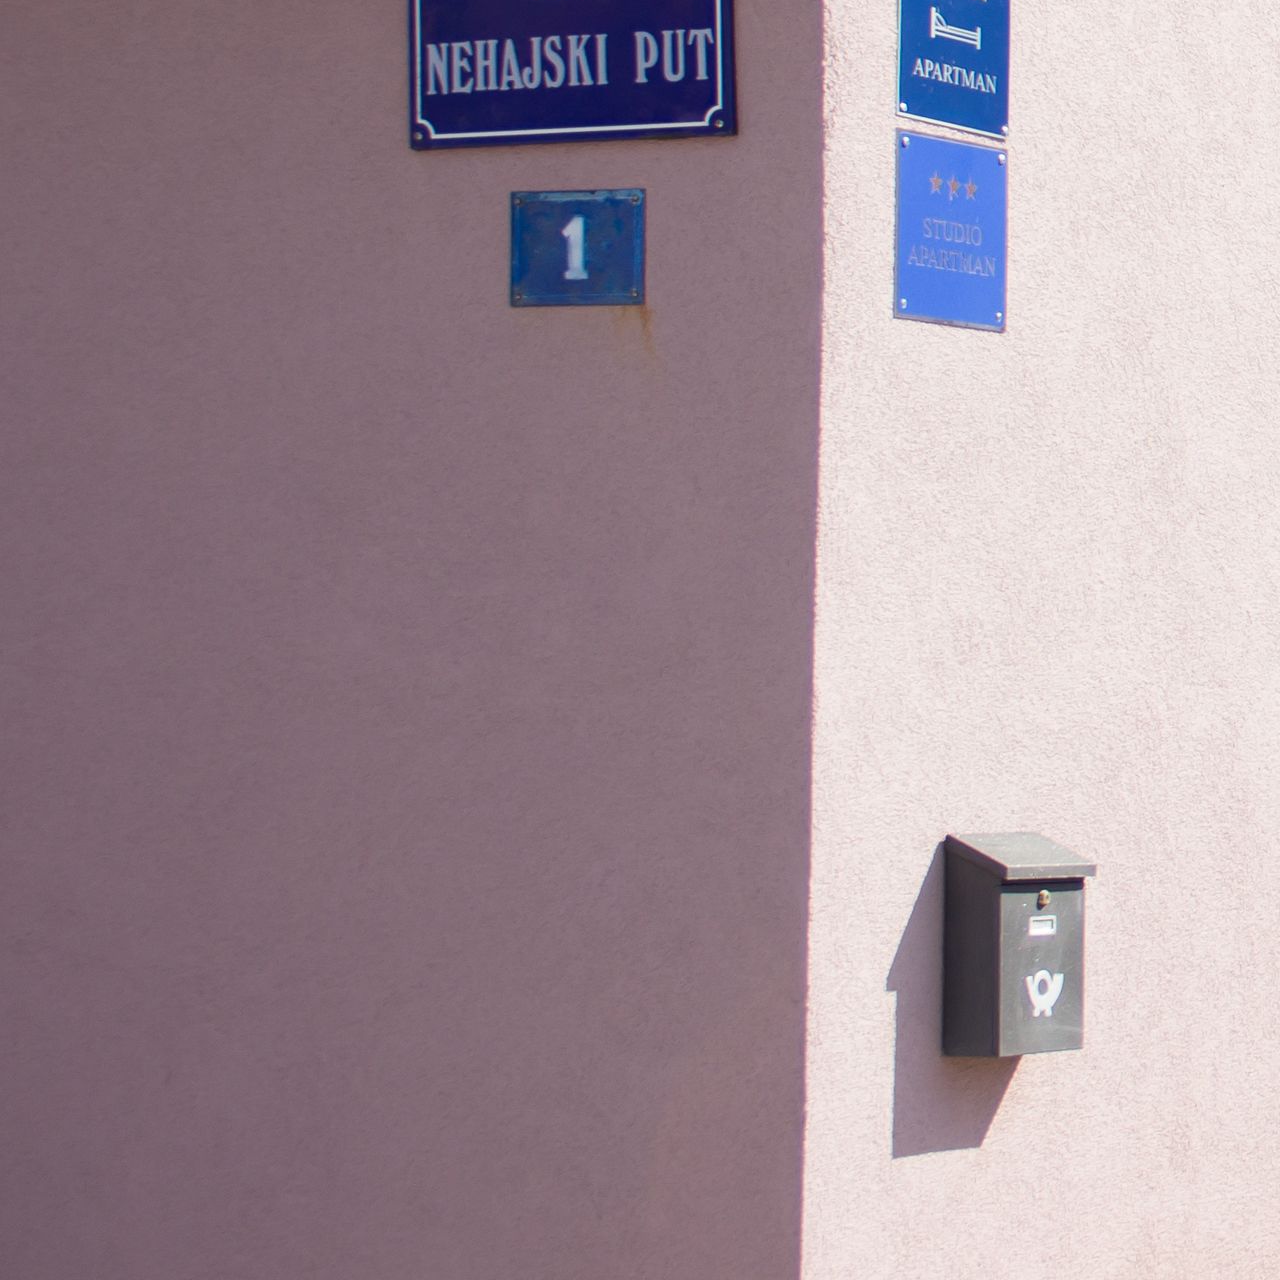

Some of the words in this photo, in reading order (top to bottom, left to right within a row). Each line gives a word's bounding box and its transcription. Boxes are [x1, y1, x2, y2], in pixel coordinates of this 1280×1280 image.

[426, 33, 609, 96] NEHAJSKI
[634, 27, 715, 84] PUT
[912, 57, 998, 95] APARTMAN
[561, 215, 590, 280] 1
[922, 217, 984, 247] STUDIO
[907, 245, 996, 278] APARTMAN
